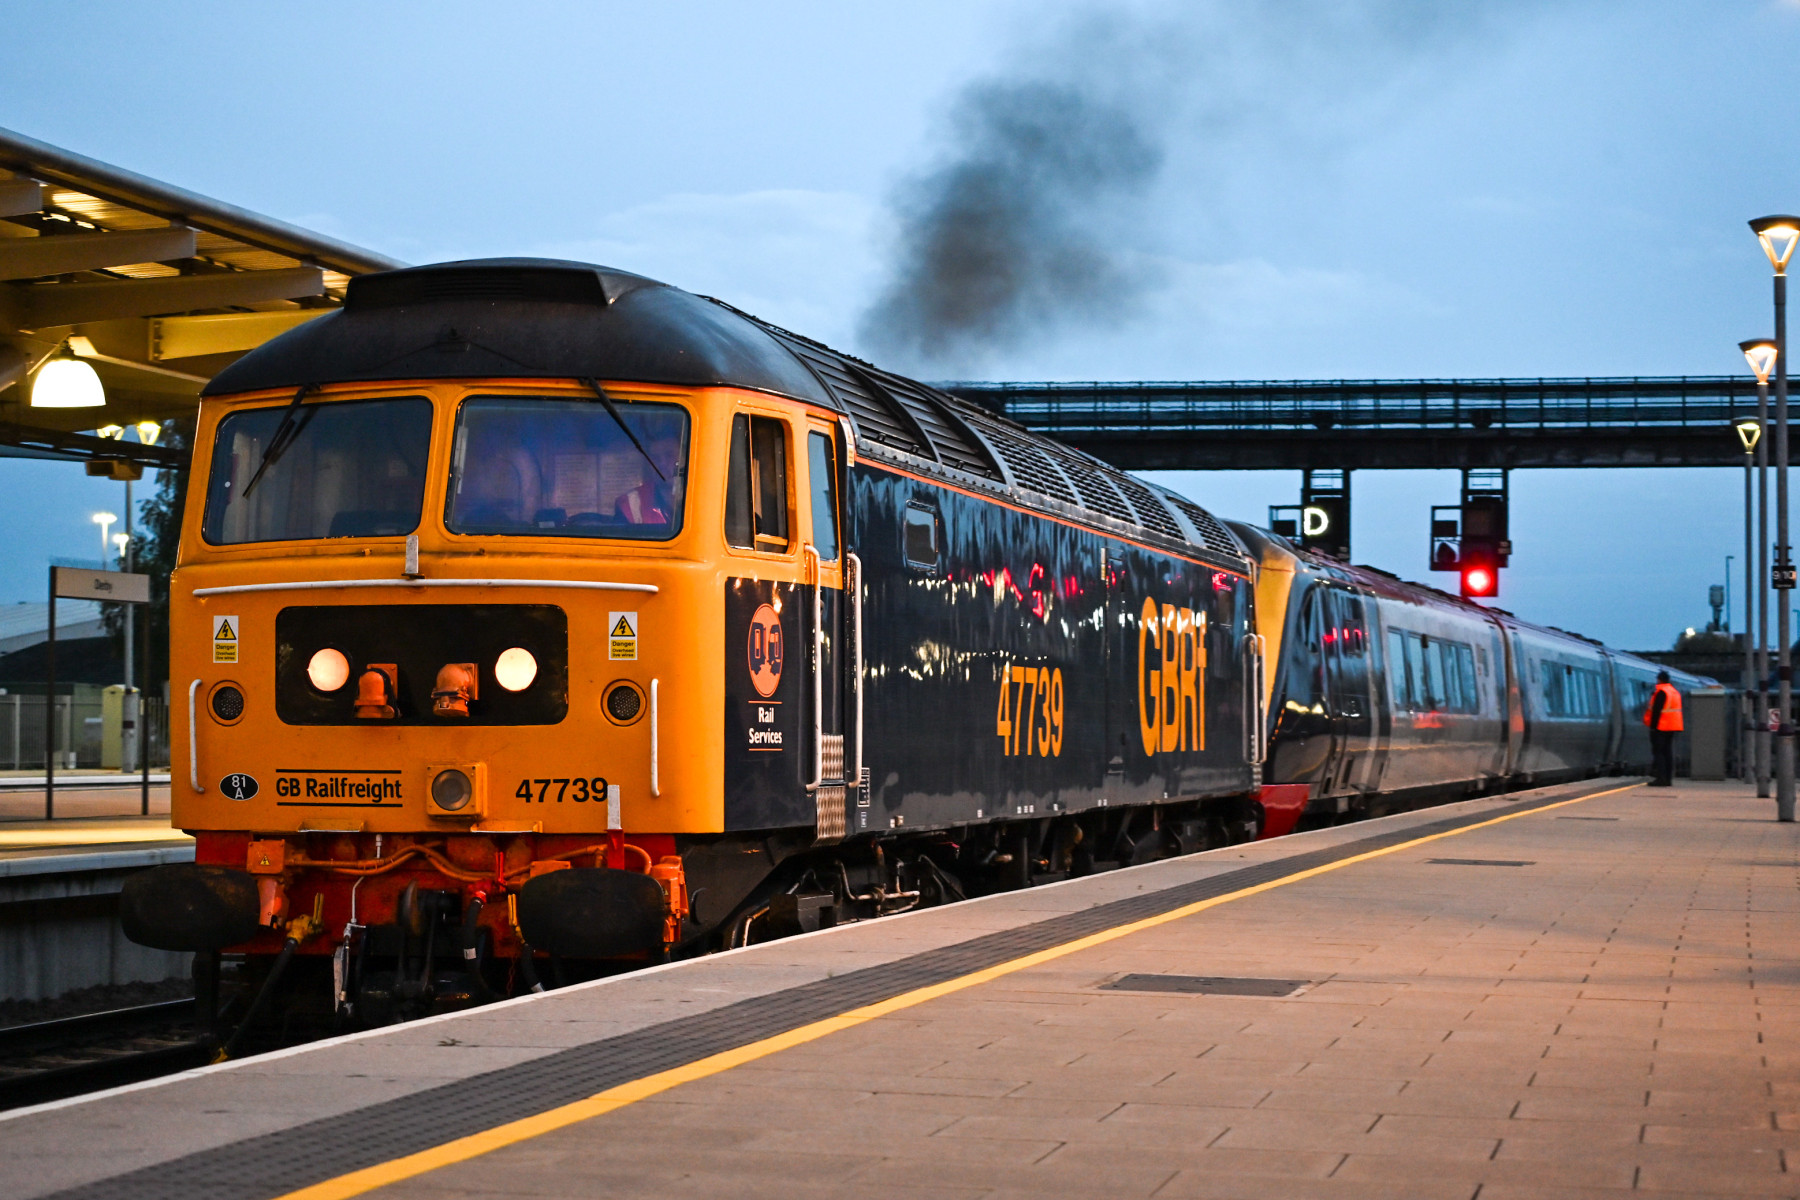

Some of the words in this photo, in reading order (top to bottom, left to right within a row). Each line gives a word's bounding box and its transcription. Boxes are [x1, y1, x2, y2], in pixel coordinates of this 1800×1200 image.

[1304, 507, 1329, 536] D
[1138, 596, 1207, 757] GBRf
[758, 706, 775, 723] Rail
[997, 666, 1064, 757] 47739
[748, 727, 783, 744] Services
[231, 775, 247, 788] 81
[235, 787, 245, 800] A
[276, 777, 301, 797] GB
[305, 777, 403, 803] Railfreight
[515, 777, 609, 803] 47739
